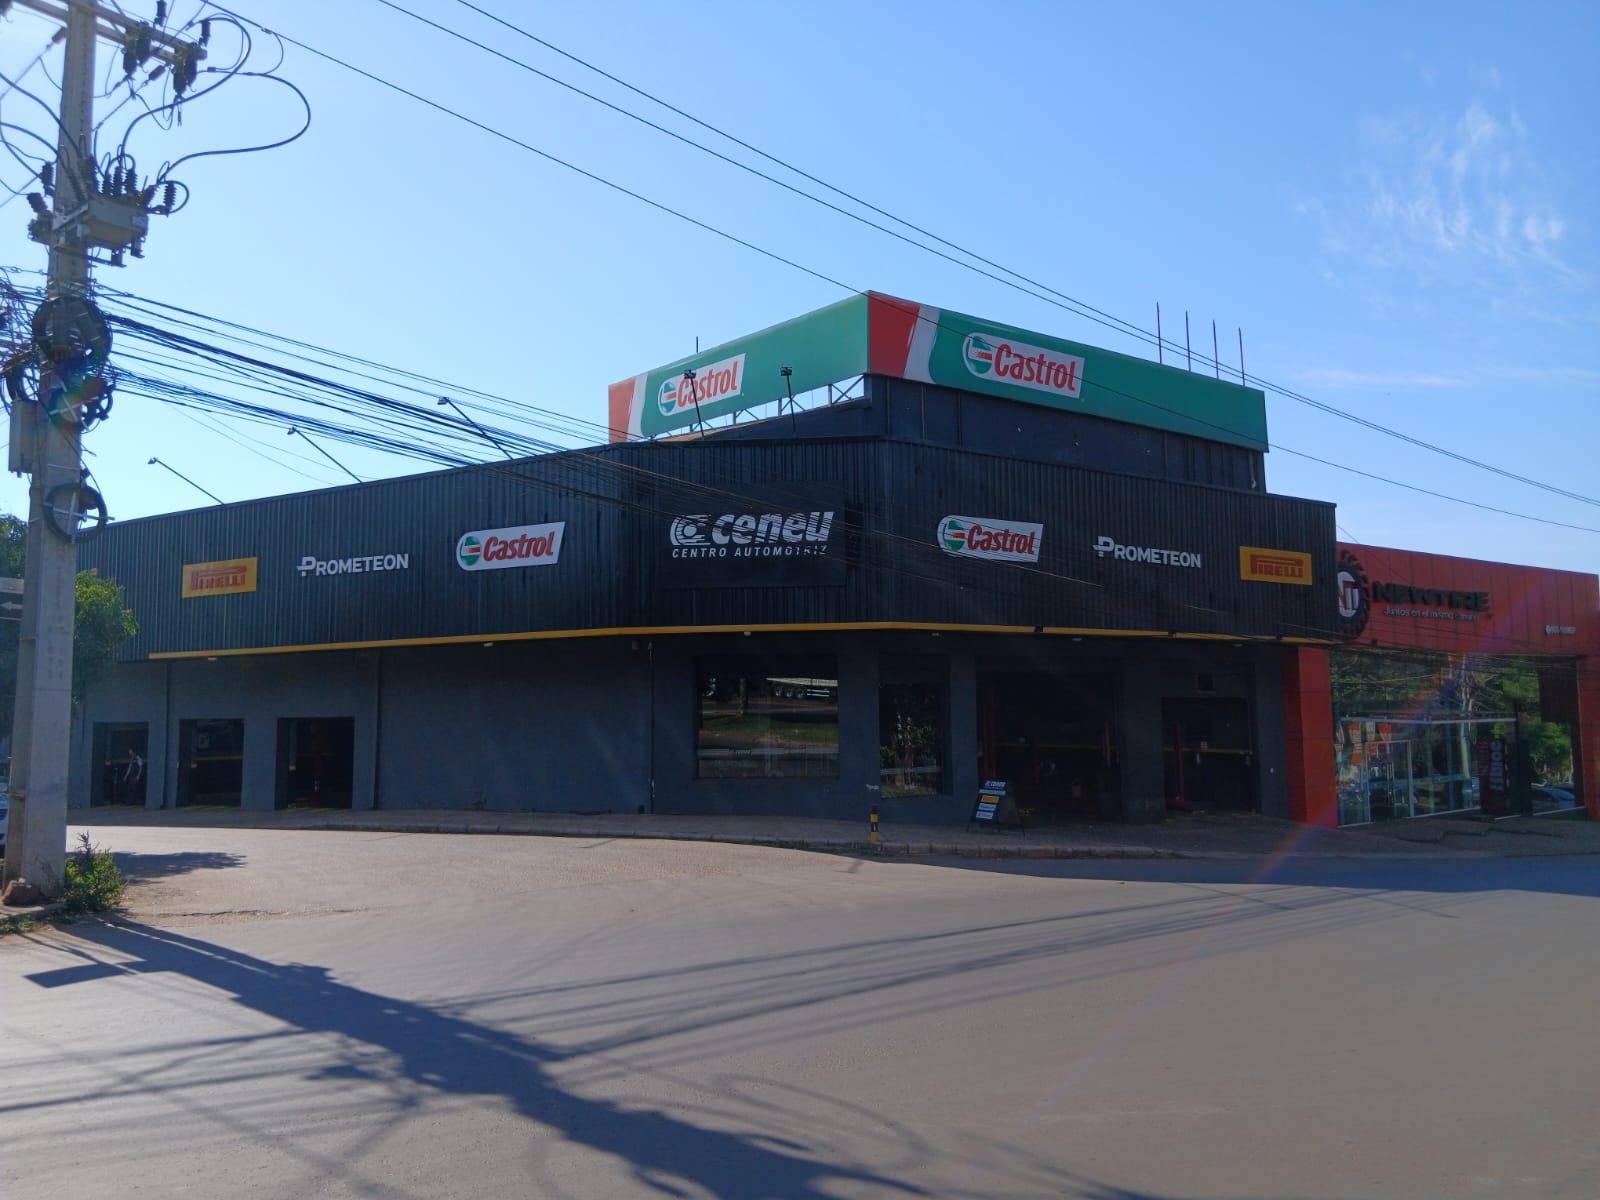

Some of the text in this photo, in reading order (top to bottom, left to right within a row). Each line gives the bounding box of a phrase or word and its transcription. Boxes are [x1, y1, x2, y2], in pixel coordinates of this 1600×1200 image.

[994, 343, 1077, 392] Castrol
[677, 361, 739, 408] Castrol
[711, 511, 835, 546] ceneu
[967, 524, 1036, 555] Castrol
[483, 531, 555, 562] Castrol
[672, 547, 728, 559] CENTRO
[190, 566, 247, 591] PIRELLI
[1250, 554, 1304, 579] PIRELLI
[1373, 581, 1489, 612] NEWTIRE
